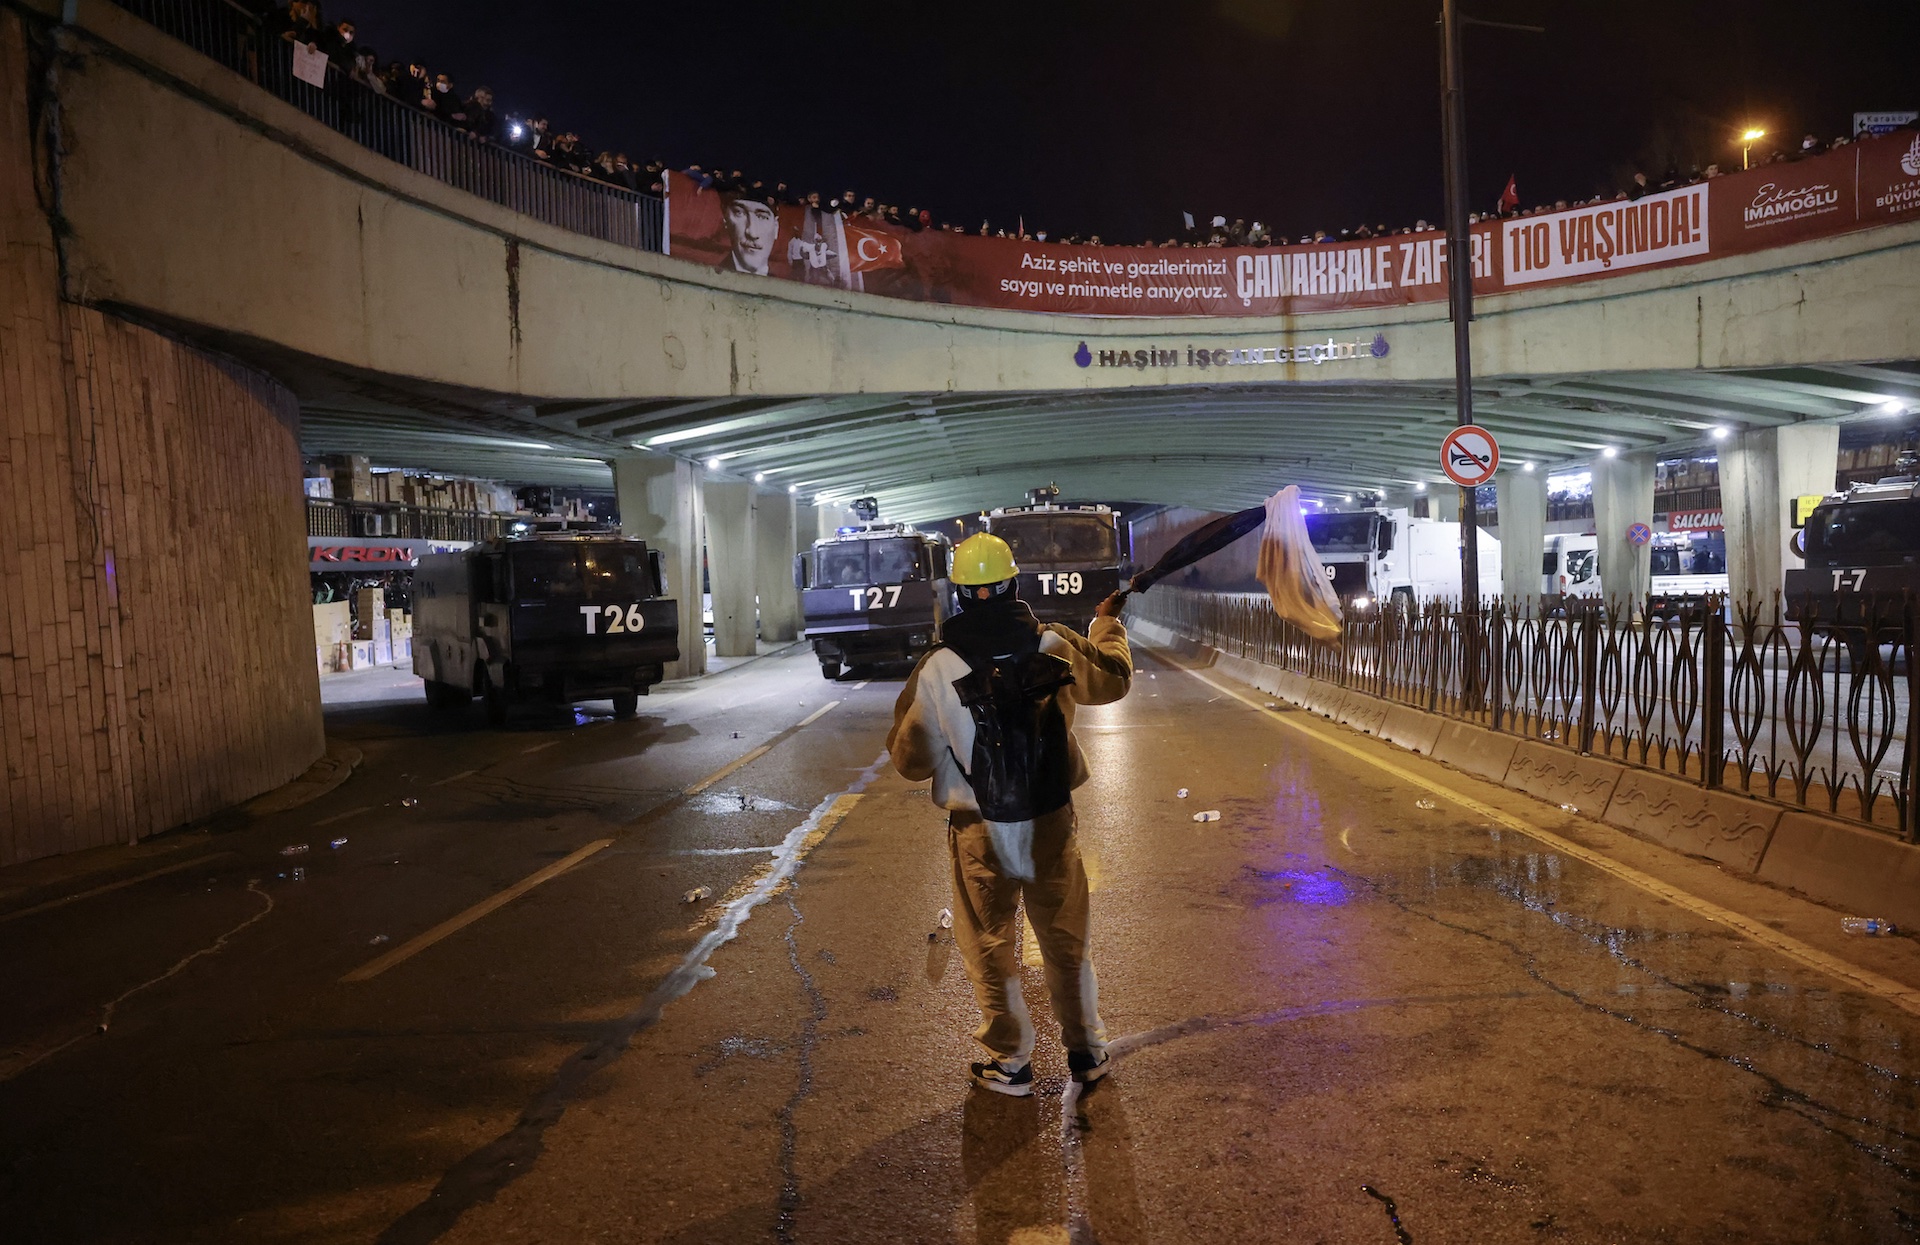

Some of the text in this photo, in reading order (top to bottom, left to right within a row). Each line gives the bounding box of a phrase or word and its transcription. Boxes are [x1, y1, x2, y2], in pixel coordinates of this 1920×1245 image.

[1744, 190, 1838, 222] İMAMOĞLU
[1509, 193, 1700, 272] 110 YAŞINDA!
[1021, 253, 1227, 279] Aziz şehit ve gazilerimizi
[1236, 232, 1491, 306] ÇANAKKALE ZAFRİ
[1001, 278, 1228, 302] saygı ve minnetle anıyoruz.
[1099, 345, 1177, 370] HAŞİM
[1274, 337, 1362, 364] GEÇİDİ
[311, 546, 413, 562] KRON
[1832, 569, 1867, 592] T-7
